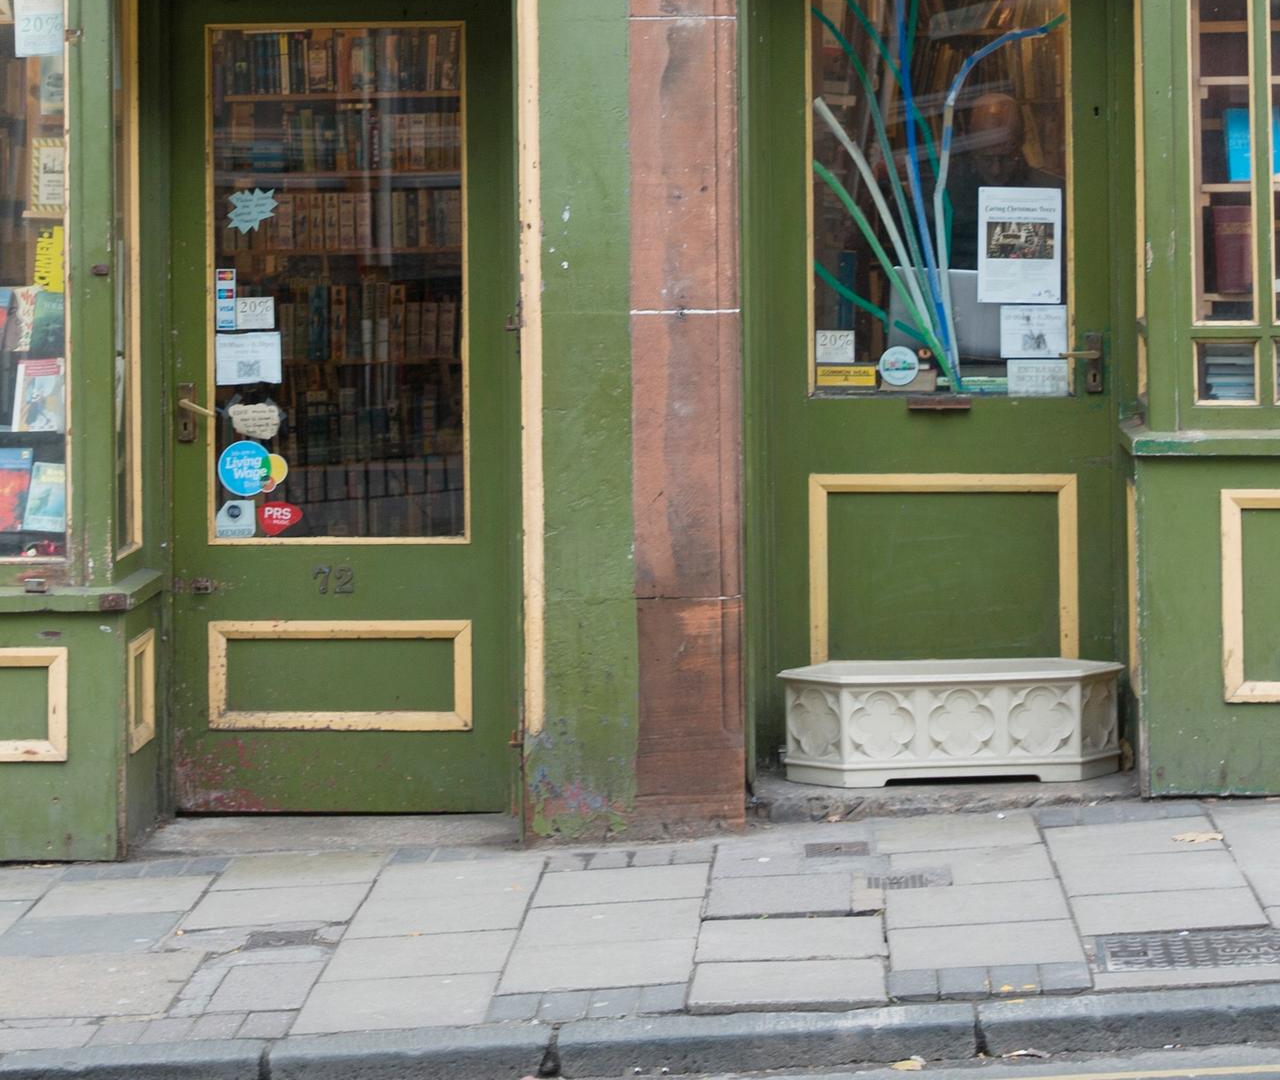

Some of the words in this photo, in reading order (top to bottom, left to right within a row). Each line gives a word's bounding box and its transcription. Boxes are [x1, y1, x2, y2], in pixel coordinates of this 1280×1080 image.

[20, 17, 64, 35] 20%
[239, 300, 273, 314] 20%
[819, 334, 853, 347] 20%
[225, 456, 263, 470] Living
[233, 467, 268, 481] Wage
[264, 507, 292, 520] PRS
[312, 566, 354, 595] 72
